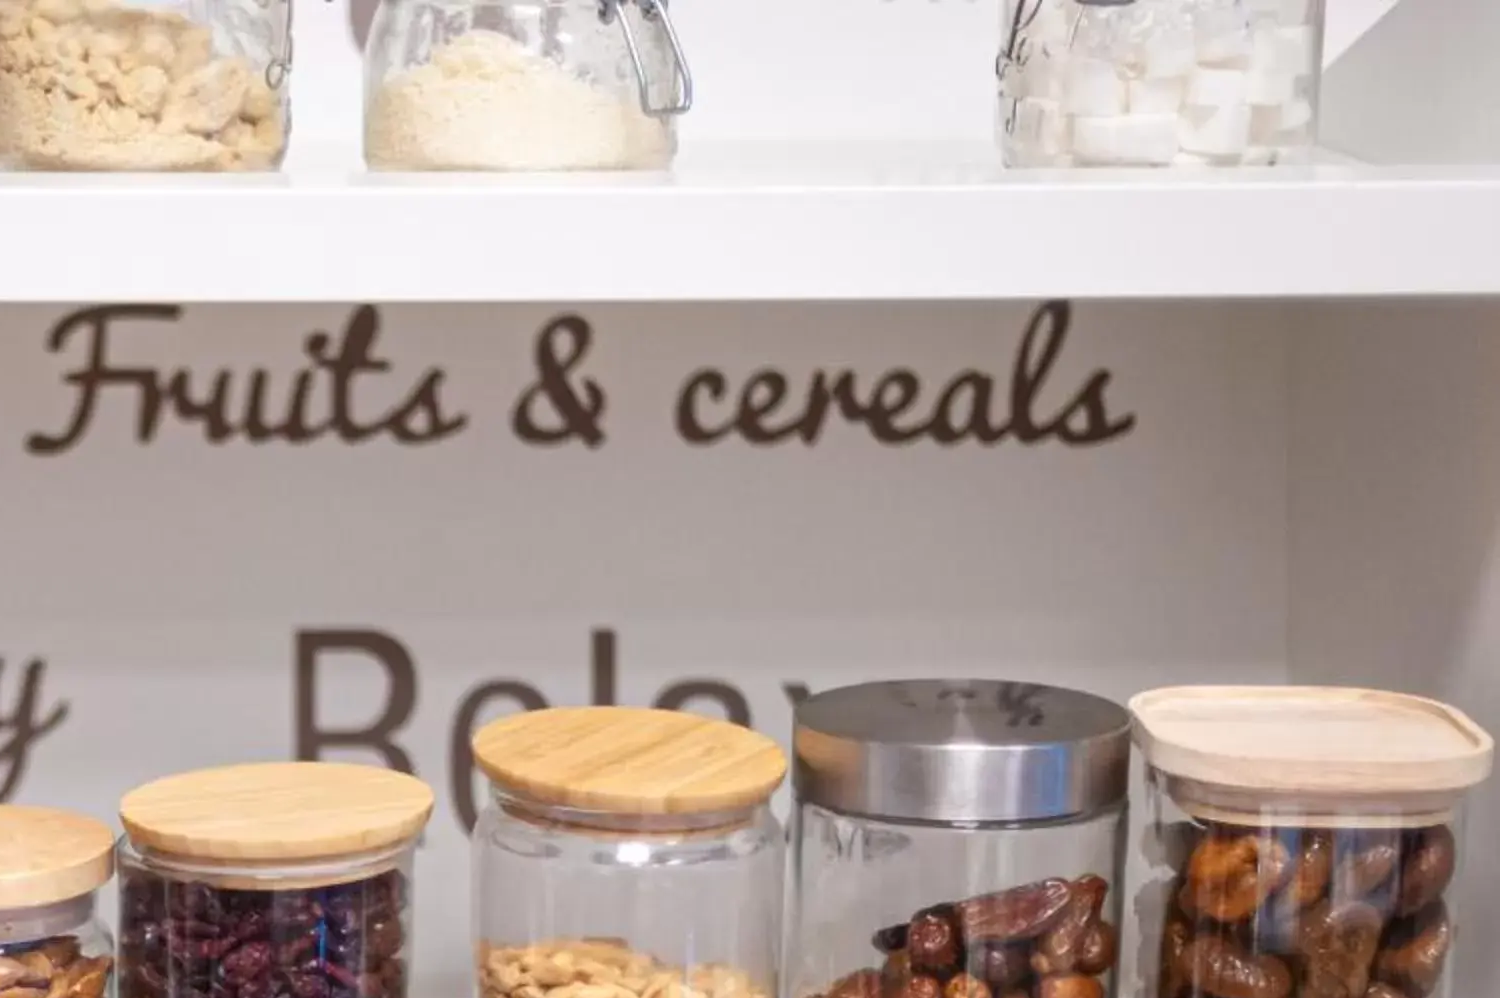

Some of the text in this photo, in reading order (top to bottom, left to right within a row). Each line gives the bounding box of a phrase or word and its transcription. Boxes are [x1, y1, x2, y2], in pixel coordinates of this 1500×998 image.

[25, 301, 1136, 456] Fruits & cereals
